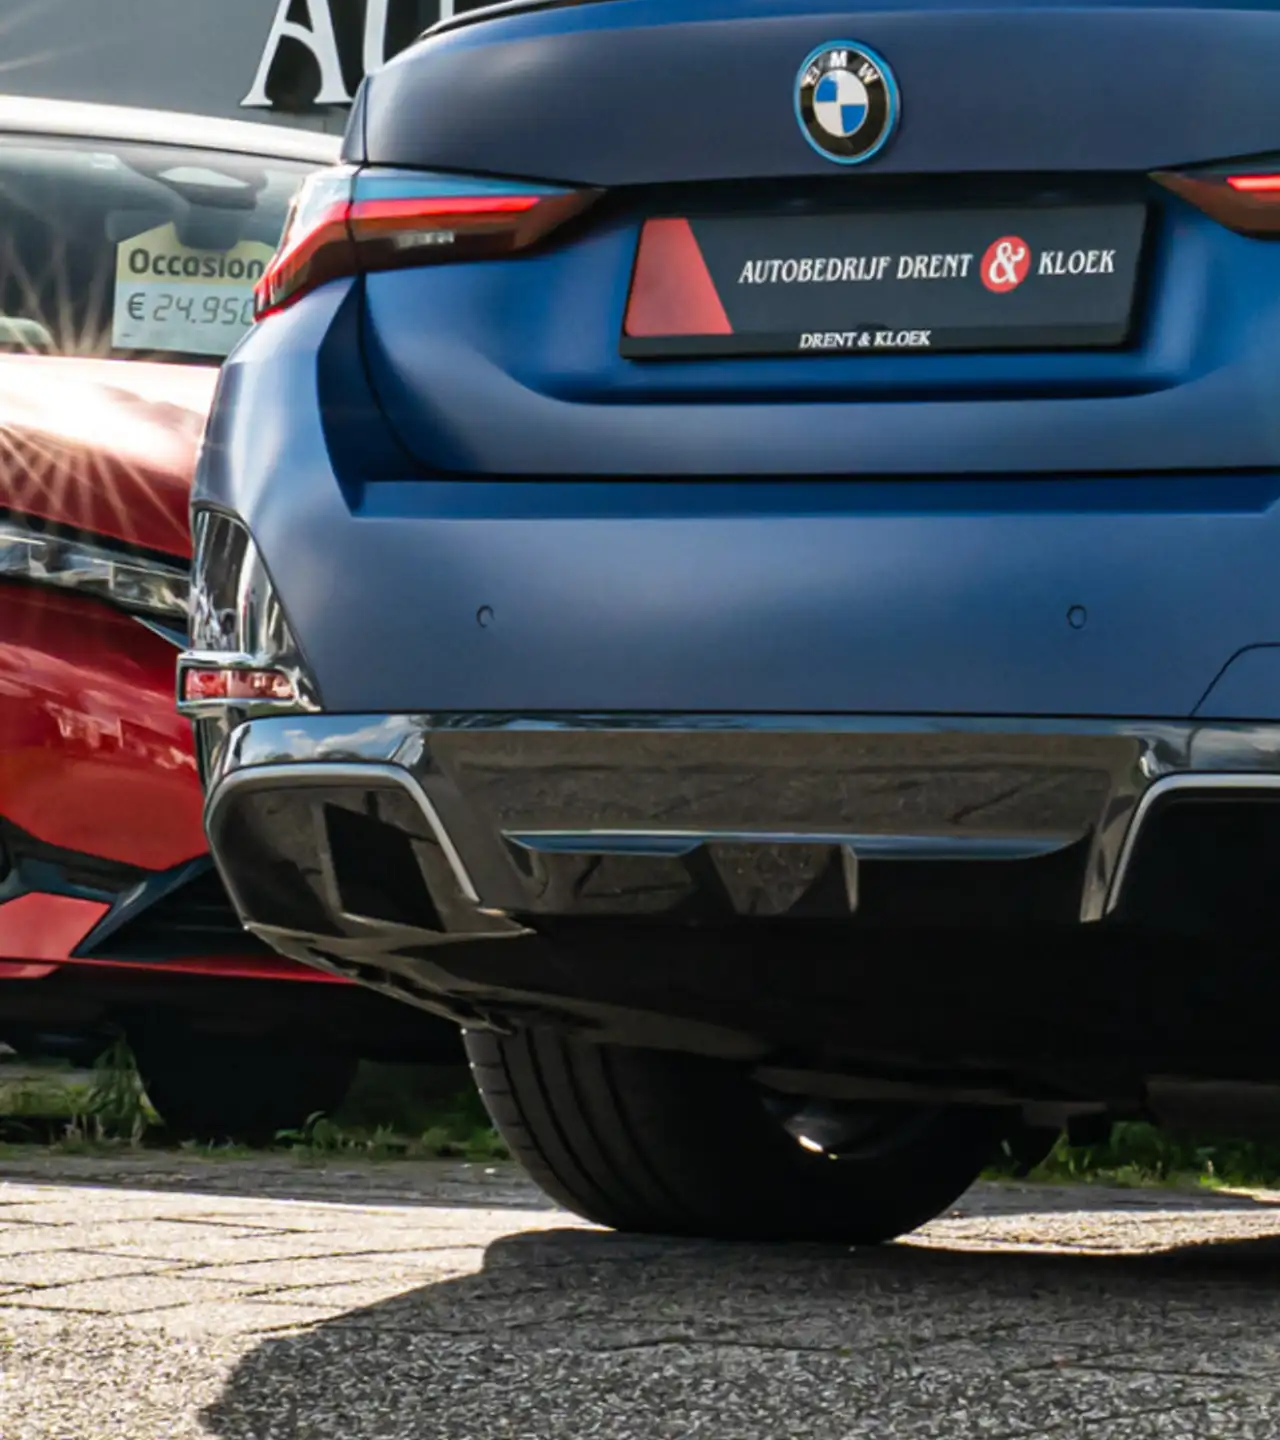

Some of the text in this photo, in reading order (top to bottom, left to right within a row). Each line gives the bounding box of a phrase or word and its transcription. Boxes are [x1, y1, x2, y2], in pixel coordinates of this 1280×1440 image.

[801, 50, 881, 88] BMW
[128, 248, 265, 279] Occasion
[738, 242, 1116, 285] AUTOBEDRIJF DRENT & KLOEK
[128, 292, 146, 320] €
[799, 329, 932, 349] DRENT & KLOEK
